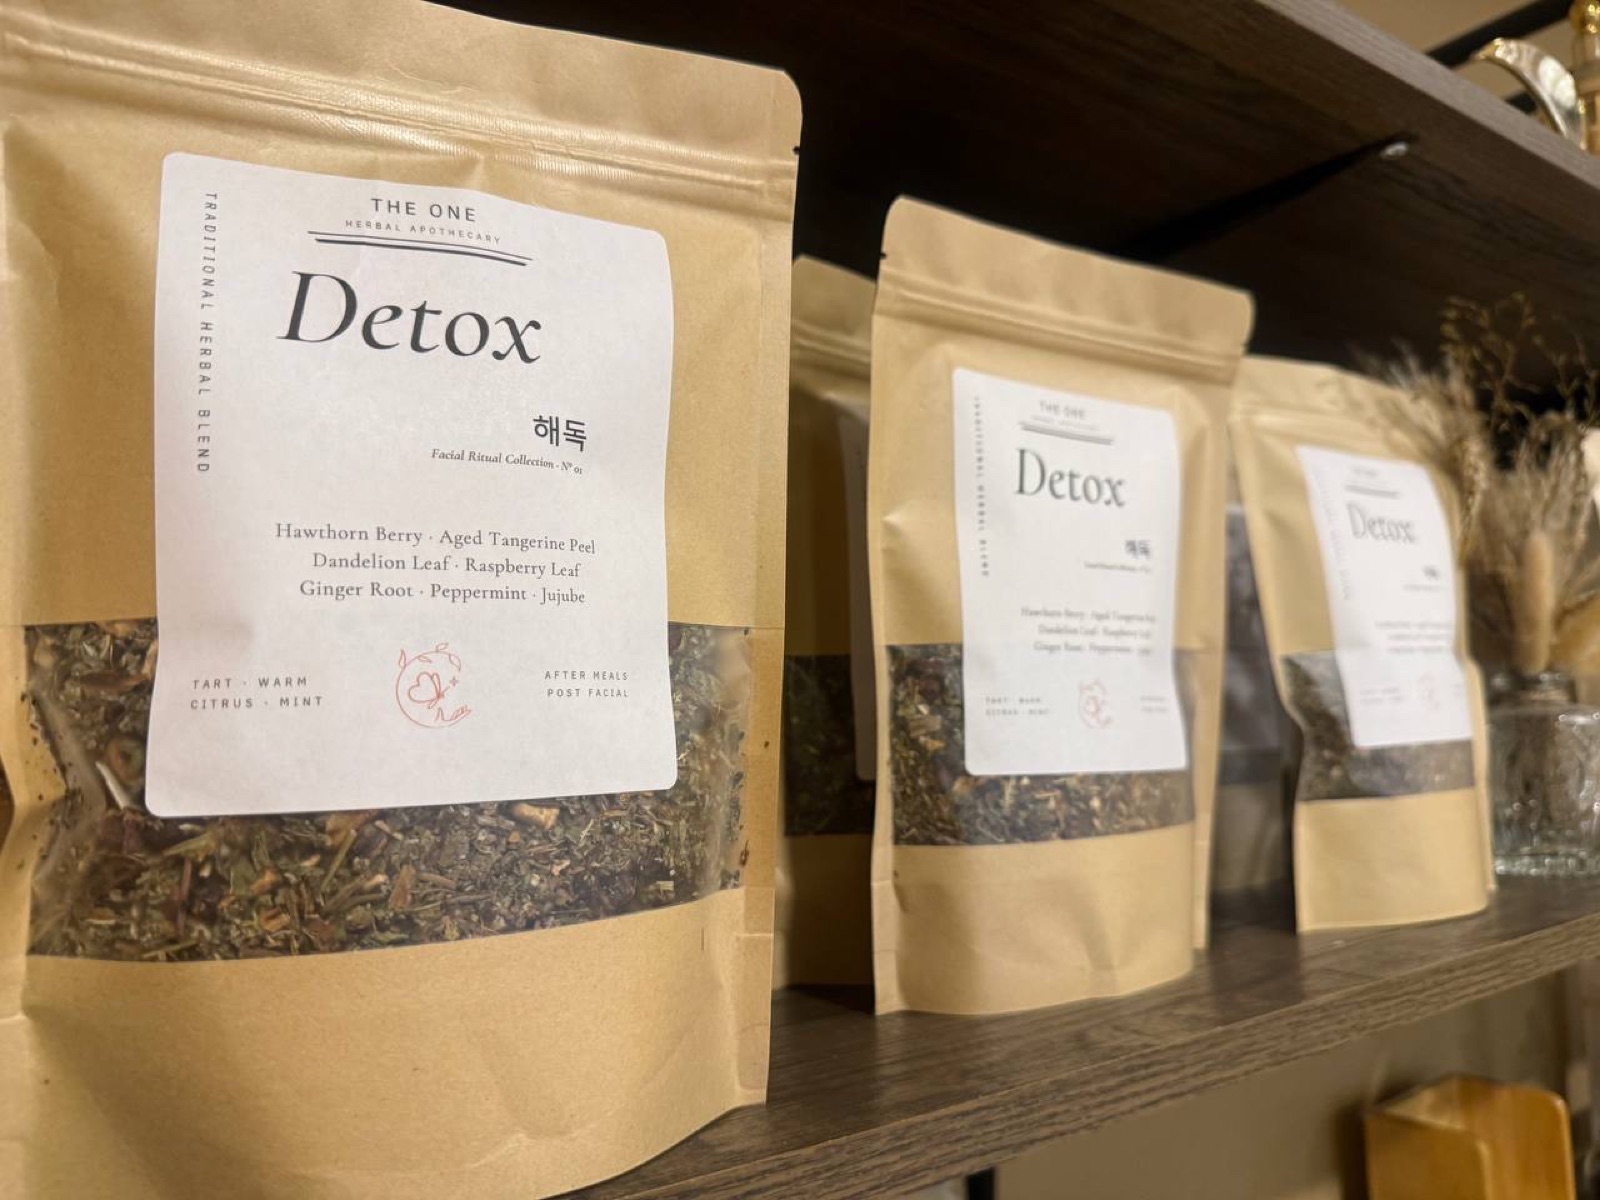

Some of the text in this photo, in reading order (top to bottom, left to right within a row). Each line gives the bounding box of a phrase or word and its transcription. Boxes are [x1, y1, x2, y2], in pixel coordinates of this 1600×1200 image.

[370, 197, 476, 223] THE ONE
[345, 219, 501, 245] HERBAL APOTHECARY
[277, 270, 541, 365] Detox
[197, 192, 218, 473] TRADITIONAL HERBAL BLEND
[532, 415, 587, 453] 해독
[431, 448, 465, 461] Facial
[468, 450, 502, 464] Ritual
[505, 454, 554, 470] Collection
[1015, 447, 1125, 508] Detox
[275, 522, 596, 555] Hawthorn Berry Aged Tangerine Peel
[313, 552, 581, 578] Dandelion Leaf Raspberry Leaf
[300, 579, 586, 606] Ginger Root Peppermint Jujube
[193, 677, 308, 690] TART WARM
[544, 670, 629, 681] AFTER MEALS
[190, 695, 323, 711] CITRUS MINT
[547, 688, 629, 698] POST FACIAL
